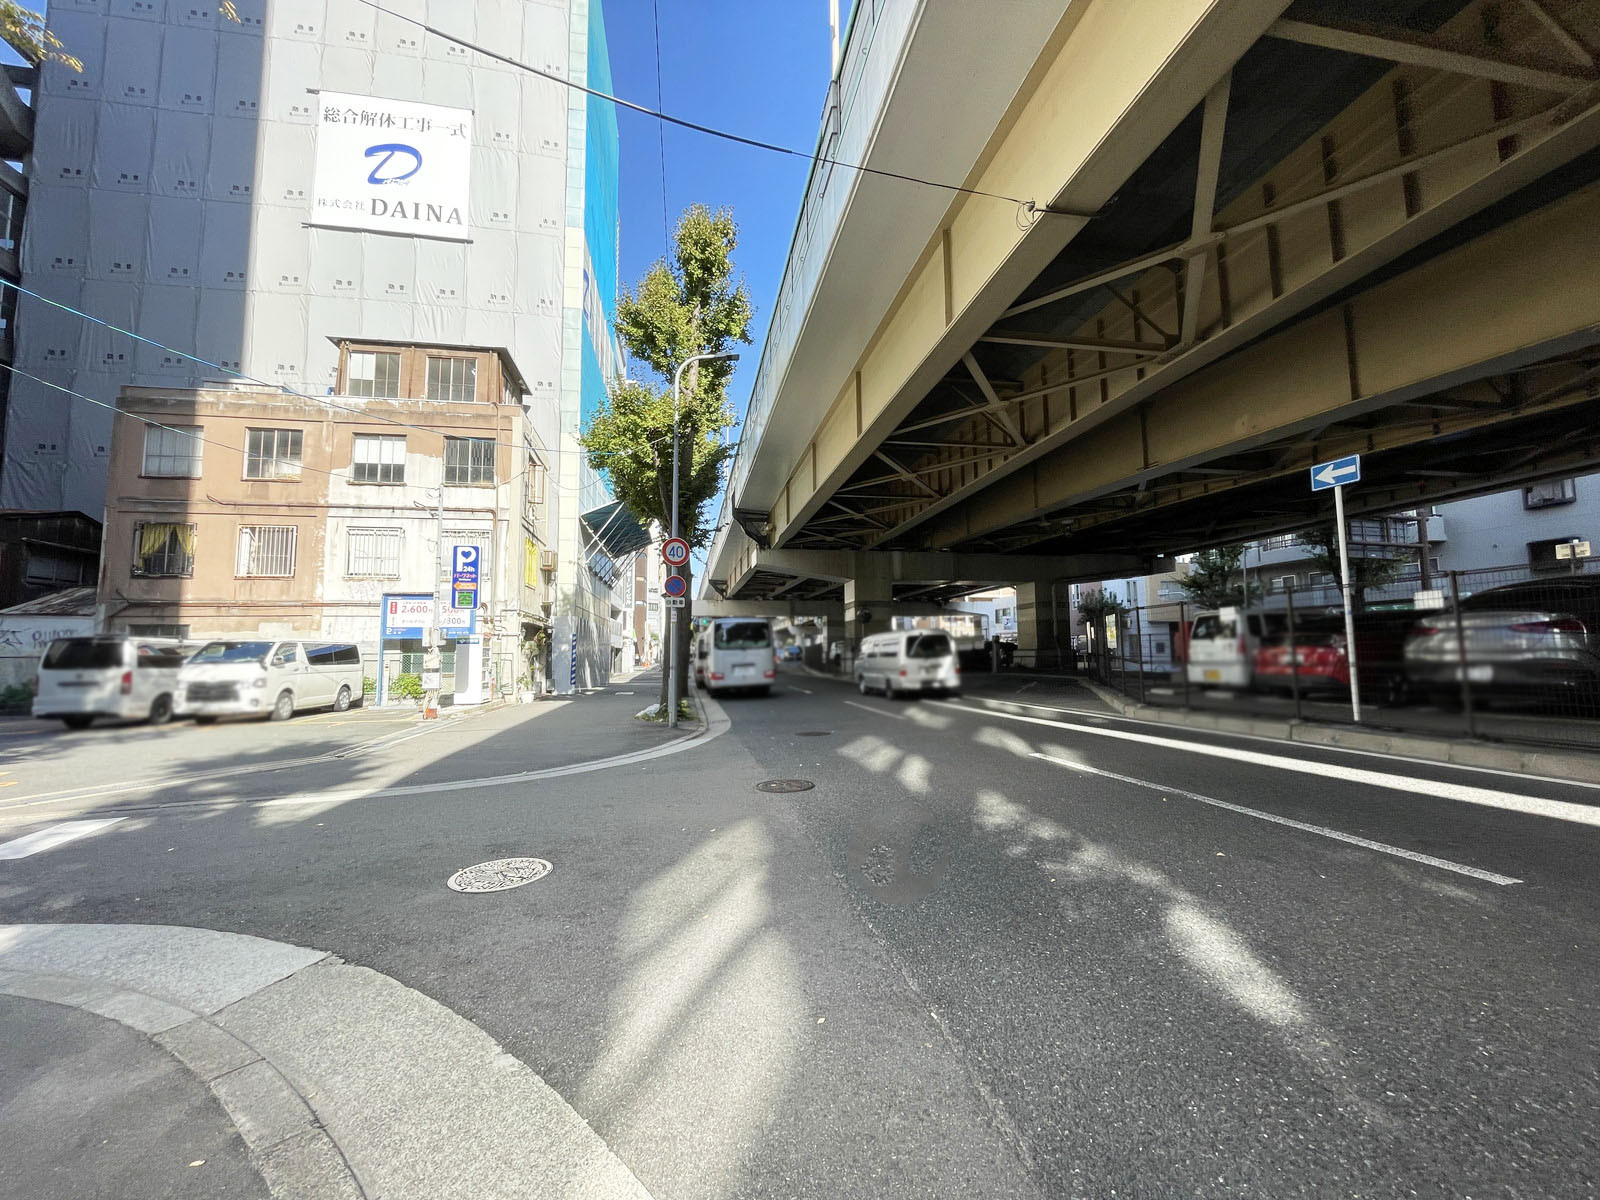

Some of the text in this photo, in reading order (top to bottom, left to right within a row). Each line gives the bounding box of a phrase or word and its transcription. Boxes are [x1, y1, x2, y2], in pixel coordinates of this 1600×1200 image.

[323, 106, 467, 138] 総合解体工事一式
[318, 197, 463, 225] 株式会社 DAINA
[668, 546, 684, 558] 40
